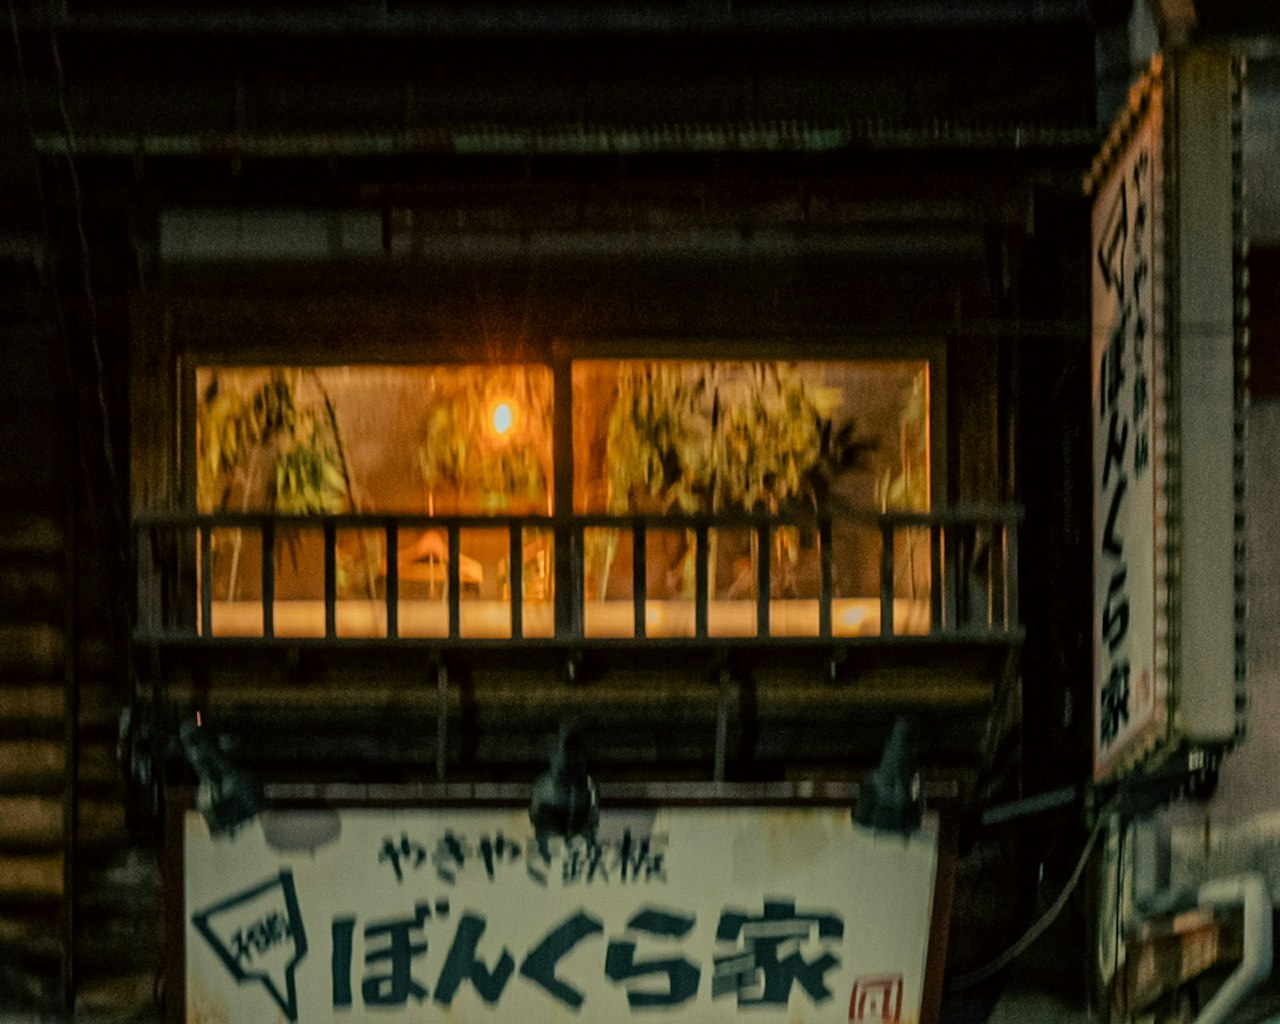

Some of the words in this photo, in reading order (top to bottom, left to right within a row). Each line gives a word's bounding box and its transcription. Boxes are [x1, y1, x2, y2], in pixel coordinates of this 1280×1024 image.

[1100, 303, 1131, 746] ぼんくら家
[332, 894, 844, 1011] ぼんくら家
